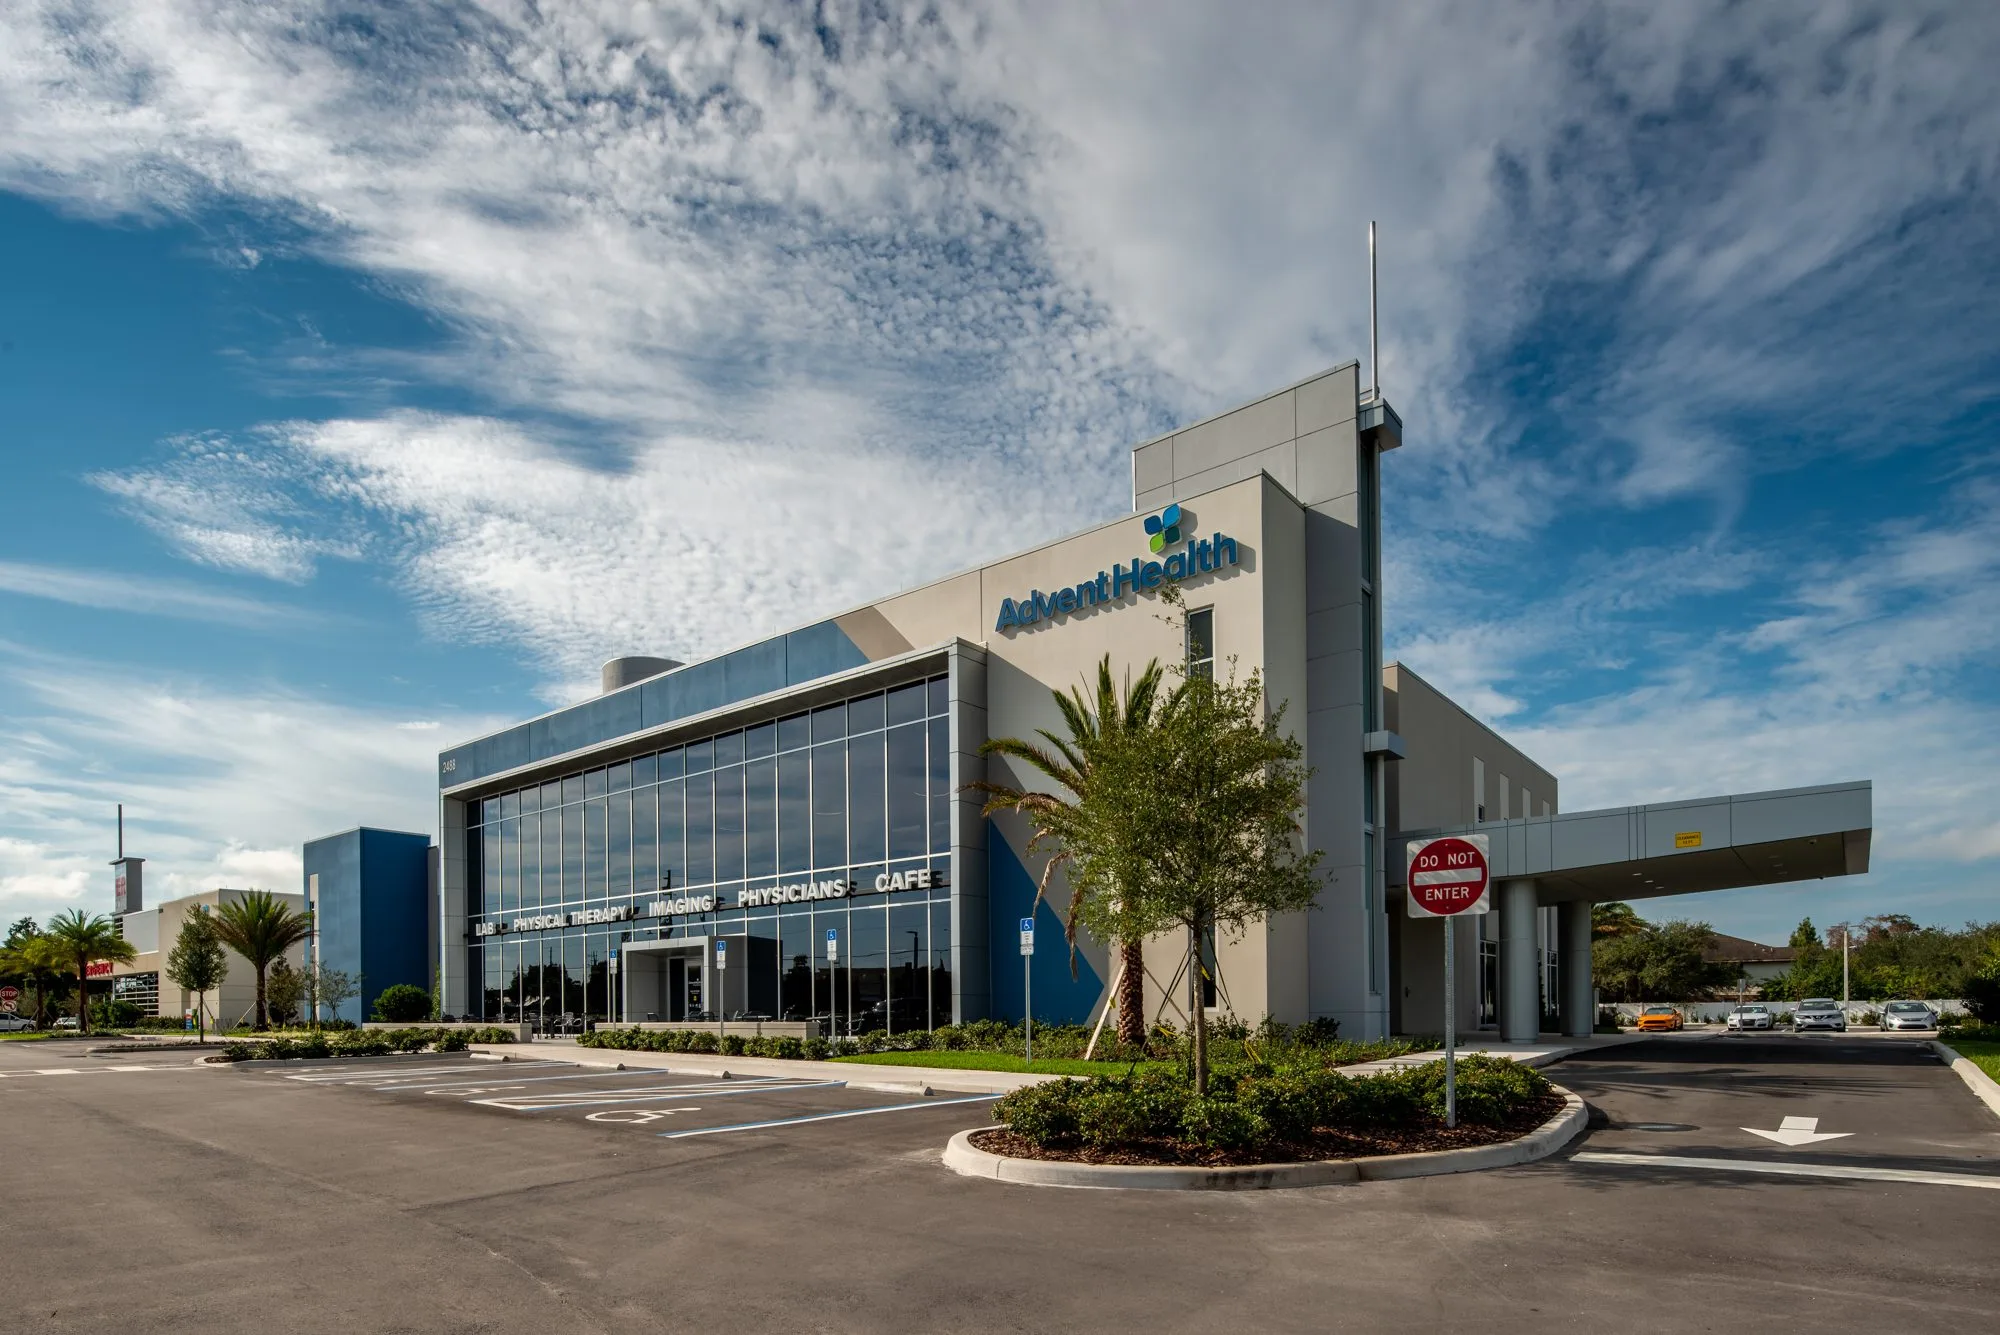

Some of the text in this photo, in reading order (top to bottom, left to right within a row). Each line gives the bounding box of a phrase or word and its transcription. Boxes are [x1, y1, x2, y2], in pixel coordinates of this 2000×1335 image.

[995, 532, 1238, 632] AdventHealth
[1420, 851, 1475, 868] DO NOT
[475, 869, 931, 936] LAB PHYSICAL THERAPY IMAGING PHYSICIANS CAFE
[1425, 886, 1469, 901] ENTER
